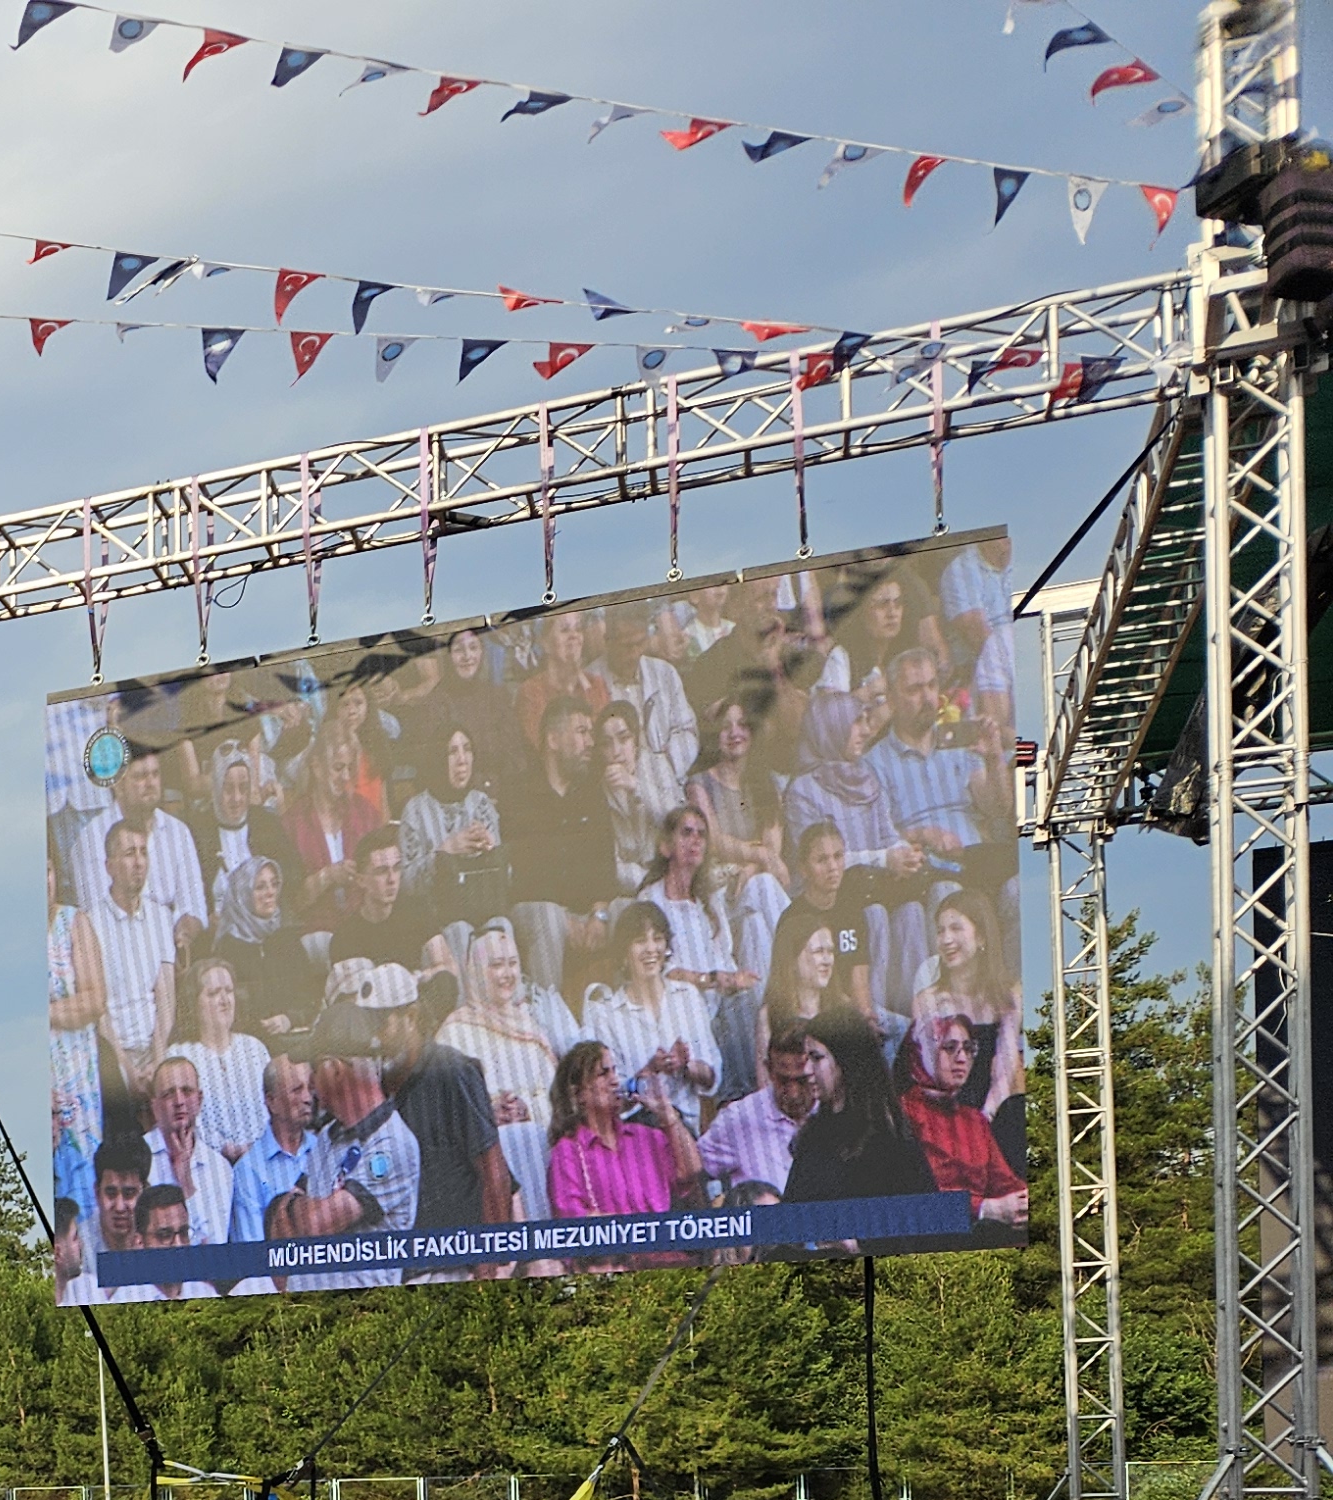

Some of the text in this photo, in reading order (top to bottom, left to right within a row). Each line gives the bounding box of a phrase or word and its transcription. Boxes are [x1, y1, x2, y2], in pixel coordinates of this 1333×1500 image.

[839, 929, 858, 952] 65
[268, 1210, 752, 1268] MÜHENDİSLİK FAKÜLTESİ MEZUNİYET TÖRENİ
